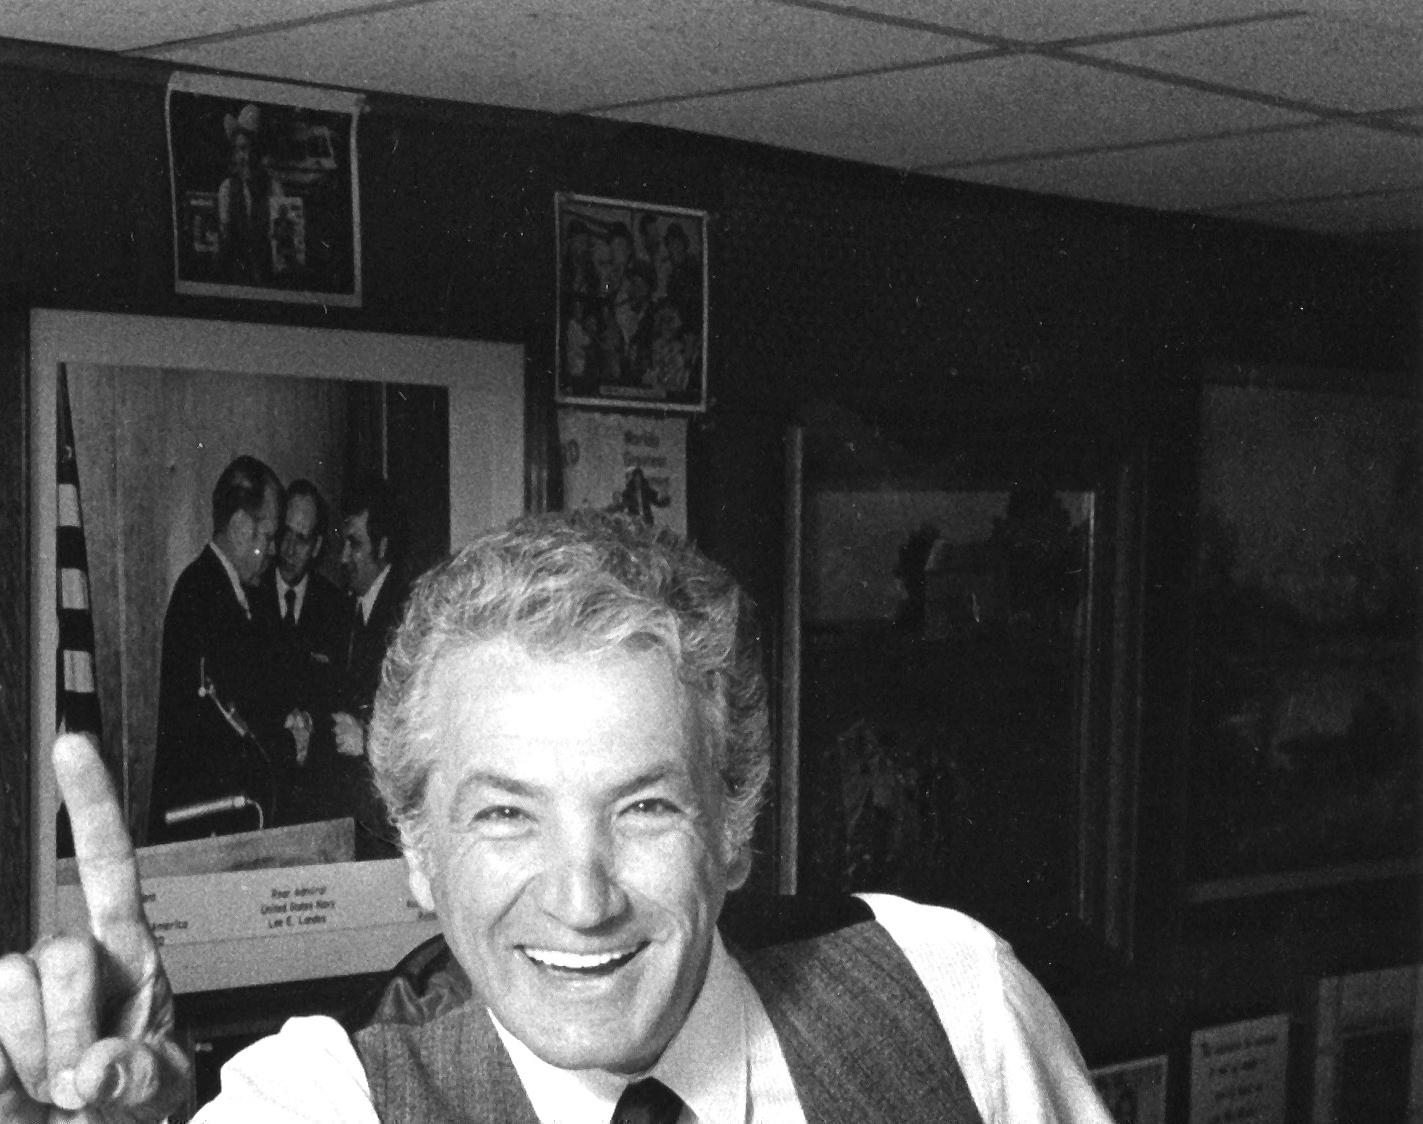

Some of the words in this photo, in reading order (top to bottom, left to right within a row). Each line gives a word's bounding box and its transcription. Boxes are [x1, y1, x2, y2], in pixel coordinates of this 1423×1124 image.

[260, 903, 288, 915] United
[289, 901, 314, 913] States
[315, 899, 336, 910] Navy
